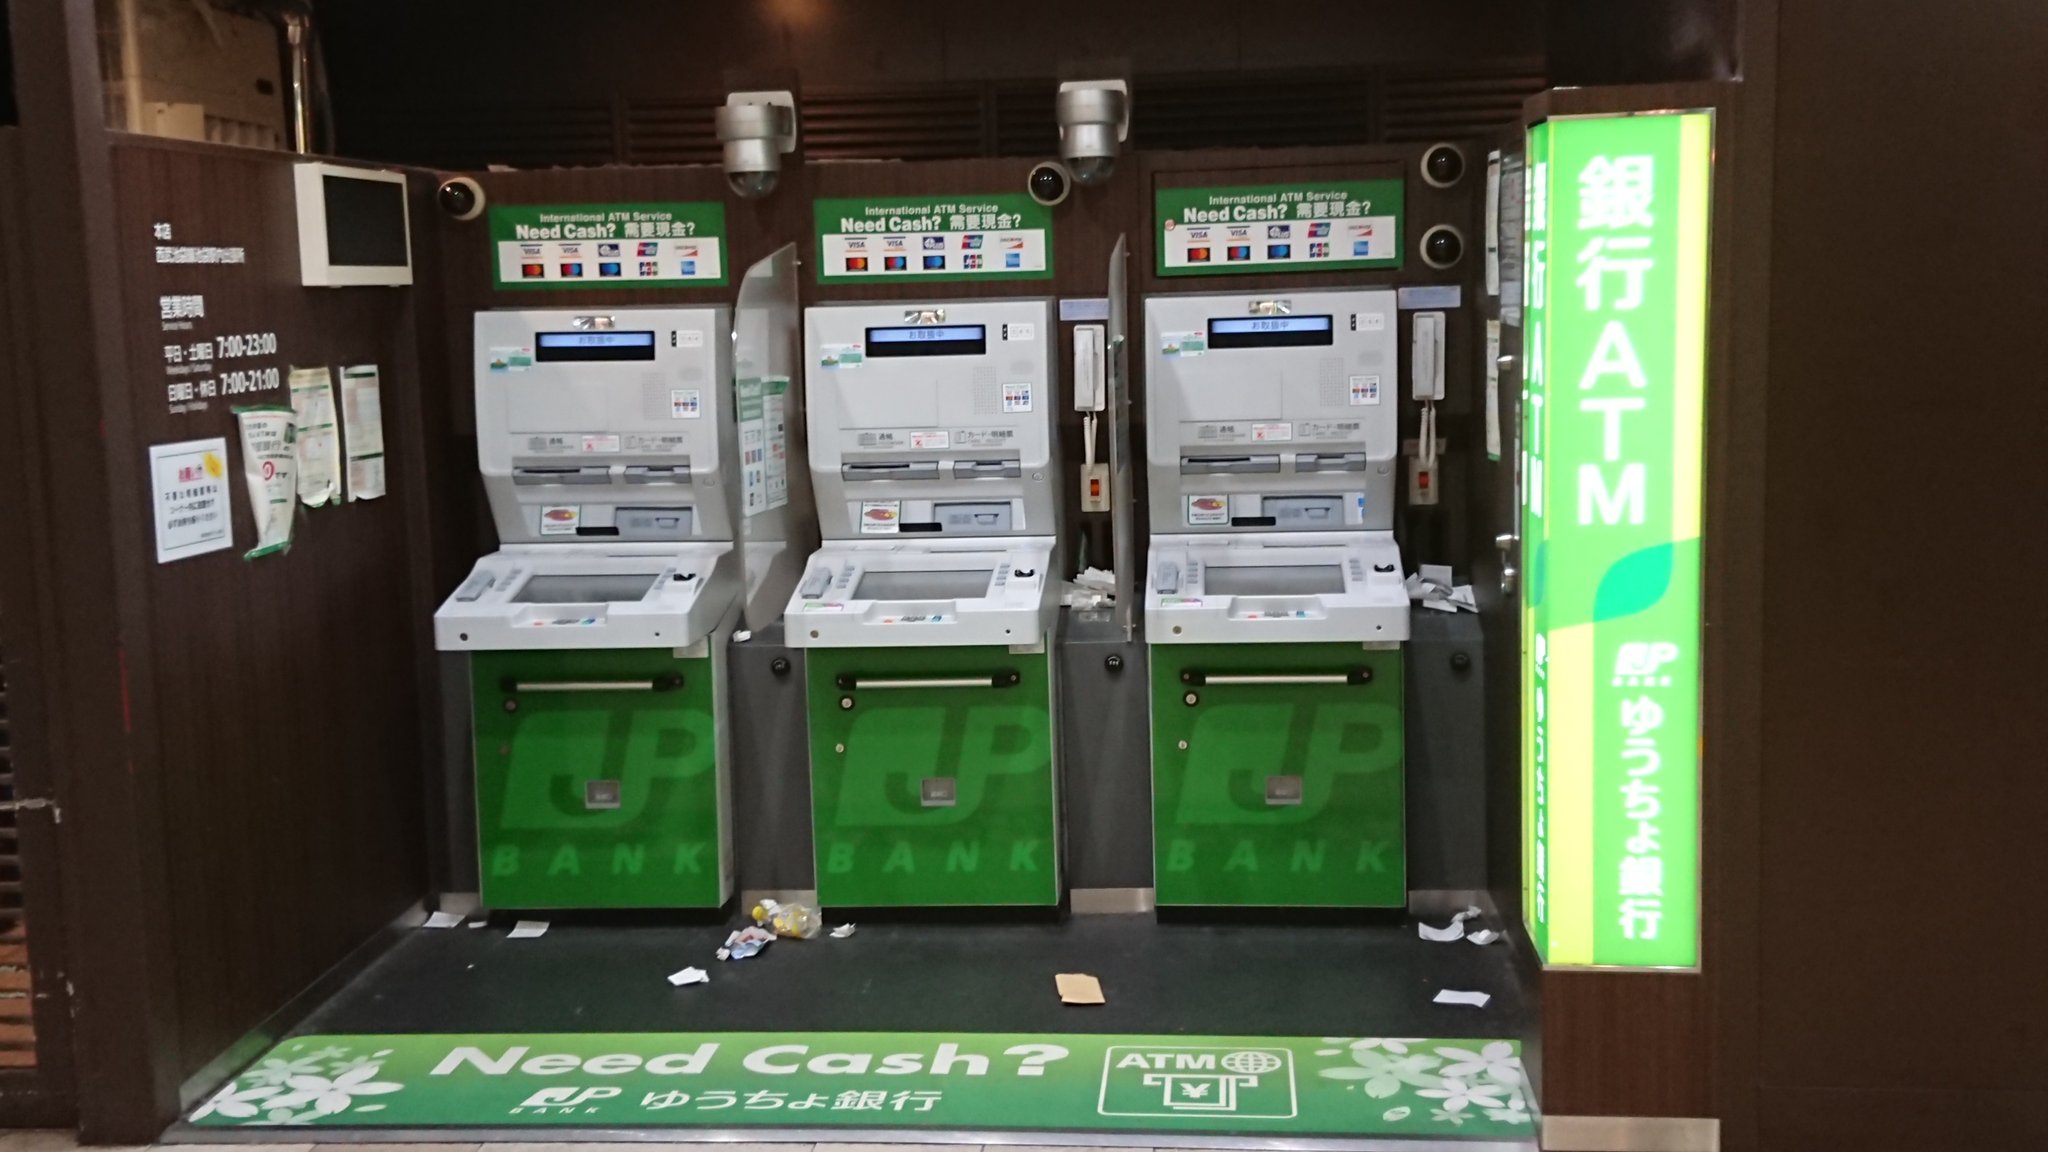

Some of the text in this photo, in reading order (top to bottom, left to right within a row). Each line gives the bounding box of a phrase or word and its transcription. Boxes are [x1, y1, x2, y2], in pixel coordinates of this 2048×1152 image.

[865, 202, 999, 216] International ATM Service
[1209, 190, 1348, 206] International ATM Service
[540, 210, 673, 223] International ATM Service
[840, 213, 1022, 233] Need Cash? 需要現金?
[1184, 200, 1372, 223] Need Cash? 需要現金?
[515, 220, 696, 239] Need Cash? 需要現金?
[159, 294, 205, 320] 営業時間
[216, 332, 278, 359] 7:00-23:00
[1575, 154, 1656, 527] 銀行ATM
[220, 367, 280, 396] 7:00-21:00
[1619, 696, 1665, 941] ゆうちょ銀行
[491, 843, 706, 877] BANK
[827, 840, 1039, 874] BANK
[1166, 839, 1388, 873] BANK
[430, 1043, 1070, 1076] Need Cash?
[1116, 1053, 1216, 1069] ATM
[509, 1106, 600, 1115] BANK
[640, 1089, 943, 1112] ゆうちょ銀行
